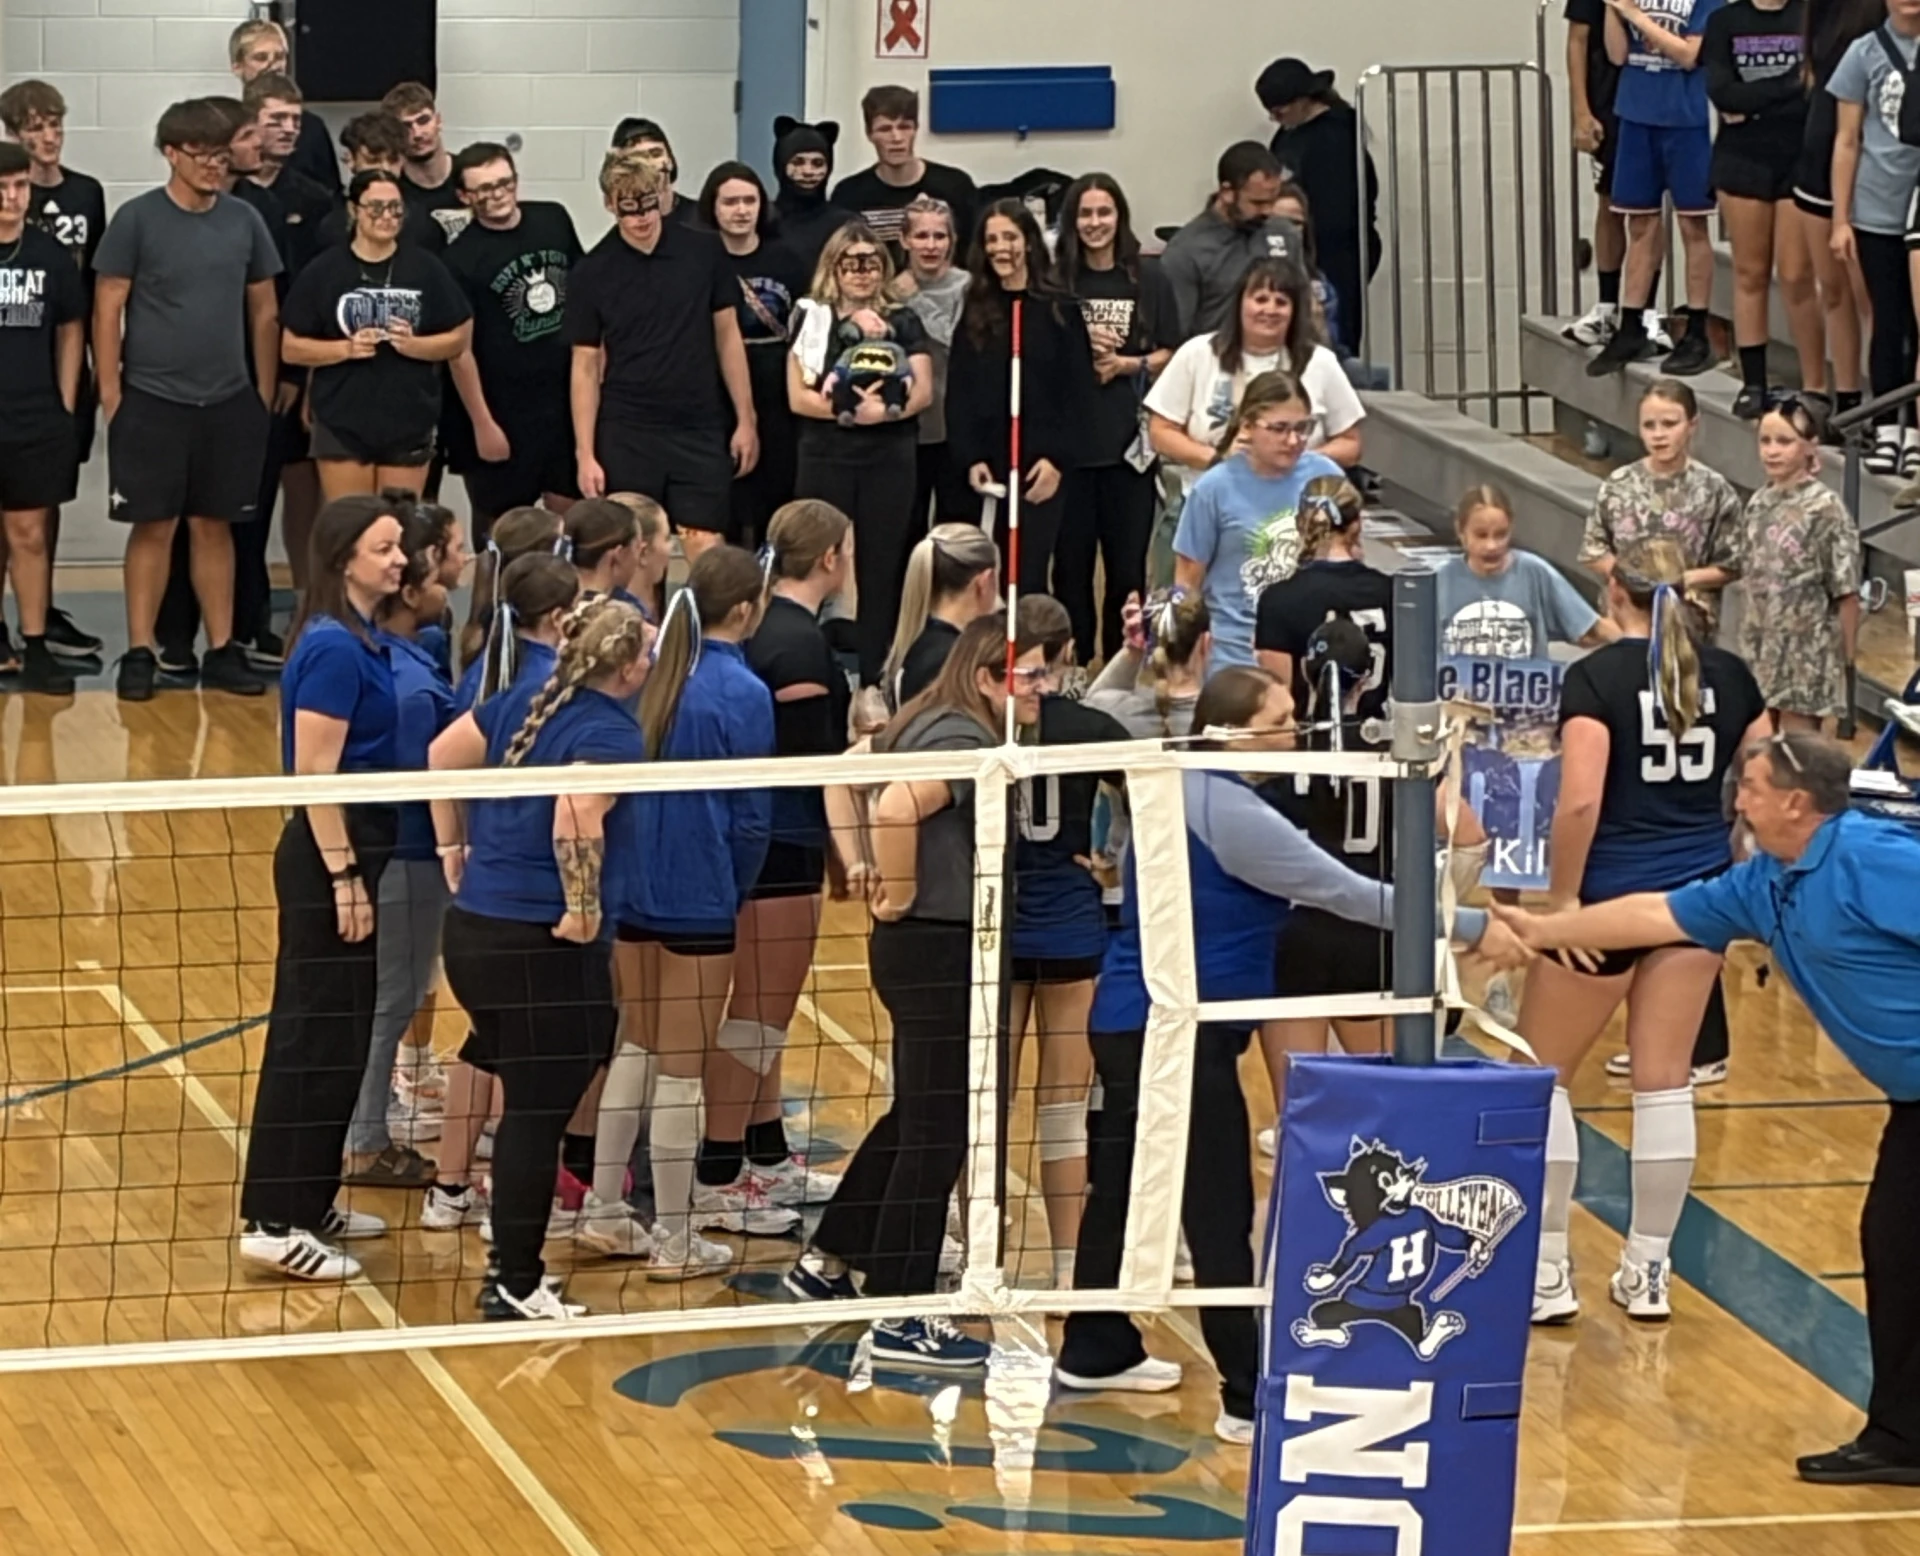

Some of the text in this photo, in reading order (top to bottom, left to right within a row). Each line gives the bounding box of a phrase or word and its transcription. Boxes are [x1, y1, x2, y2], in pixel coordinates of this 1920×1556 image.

[55, 214, 88, 245] 23
[1638, 686, 1716, 783] 55
[1387, 1229, 1428, 1283] H
